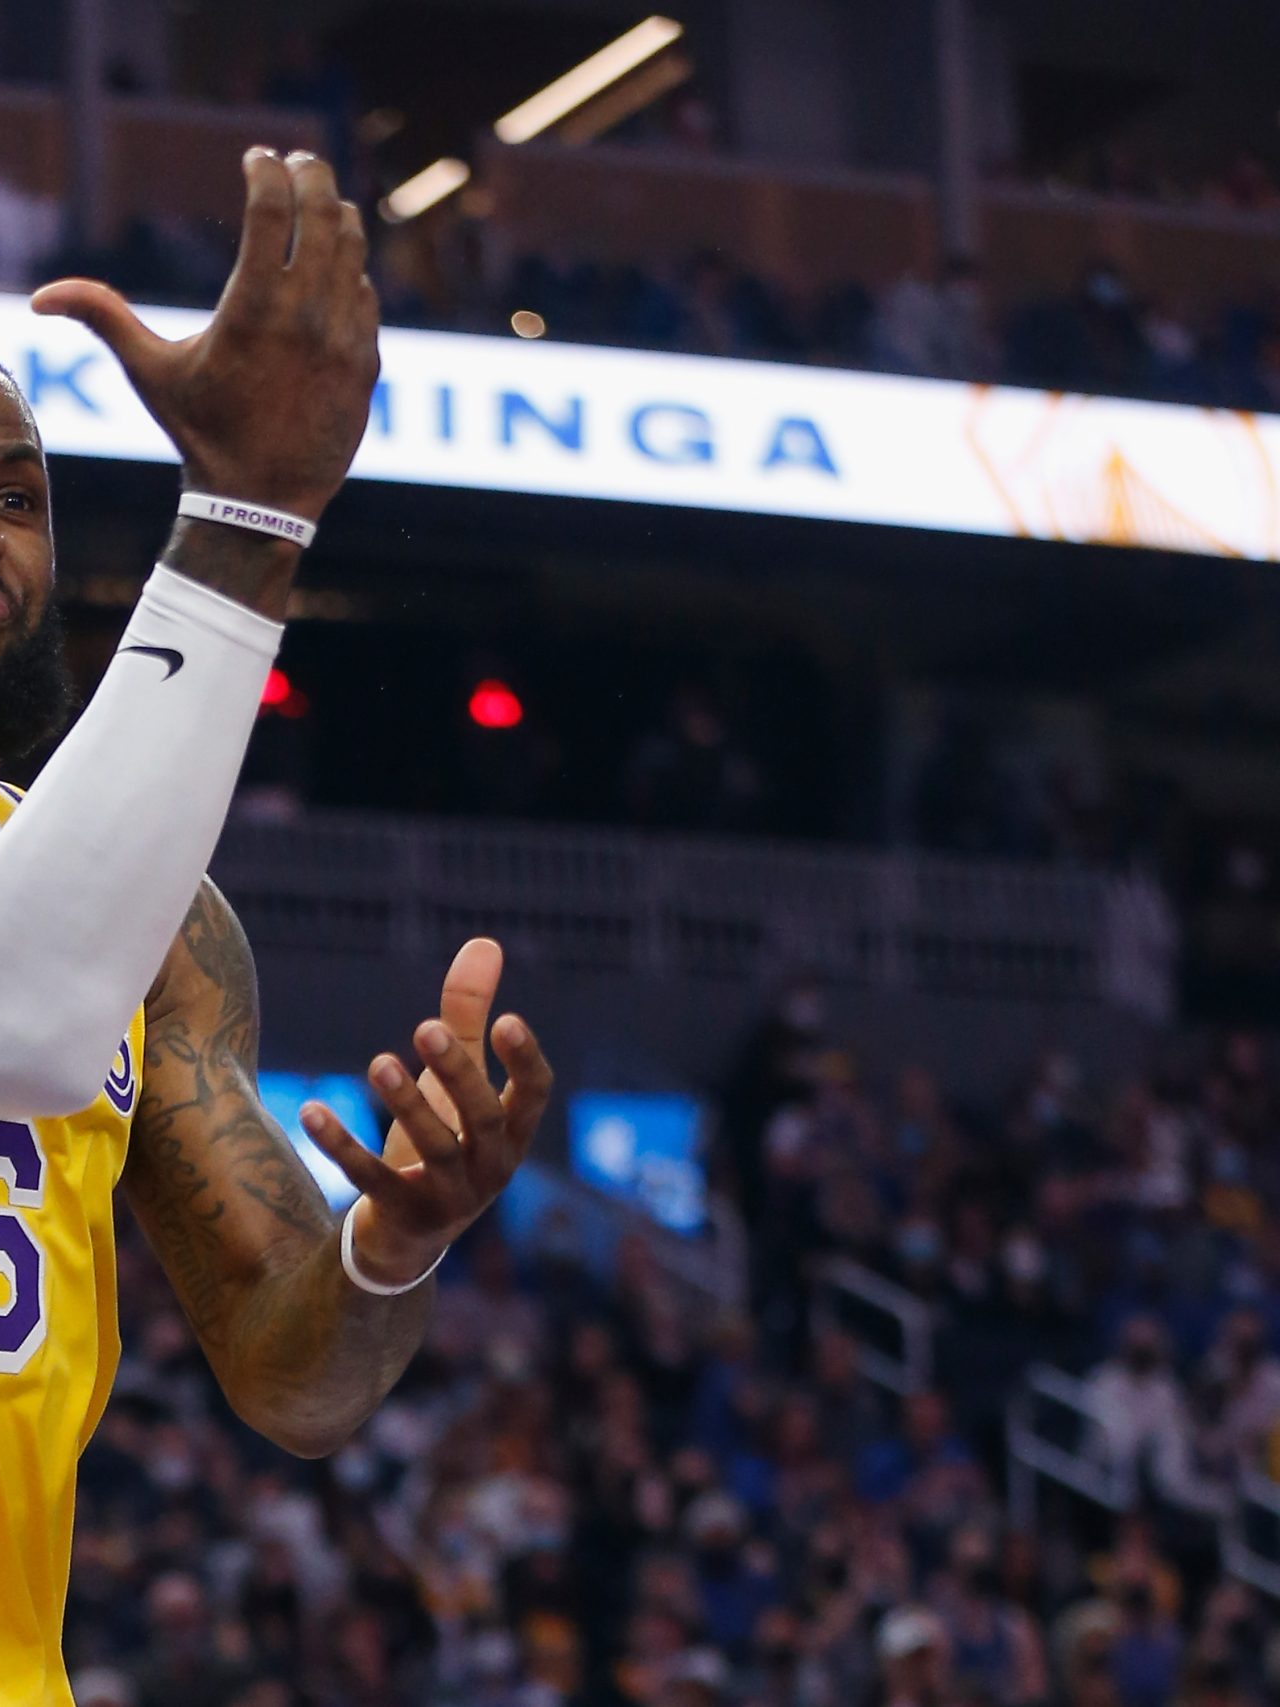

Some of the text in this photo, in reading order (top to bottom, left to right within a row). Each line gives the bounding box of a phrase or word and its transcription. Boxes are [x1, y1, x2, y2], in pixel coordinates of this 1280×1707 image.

[23, 342, 842, 482] KINGA
[210, 503, 306, 538] I PROMISE
